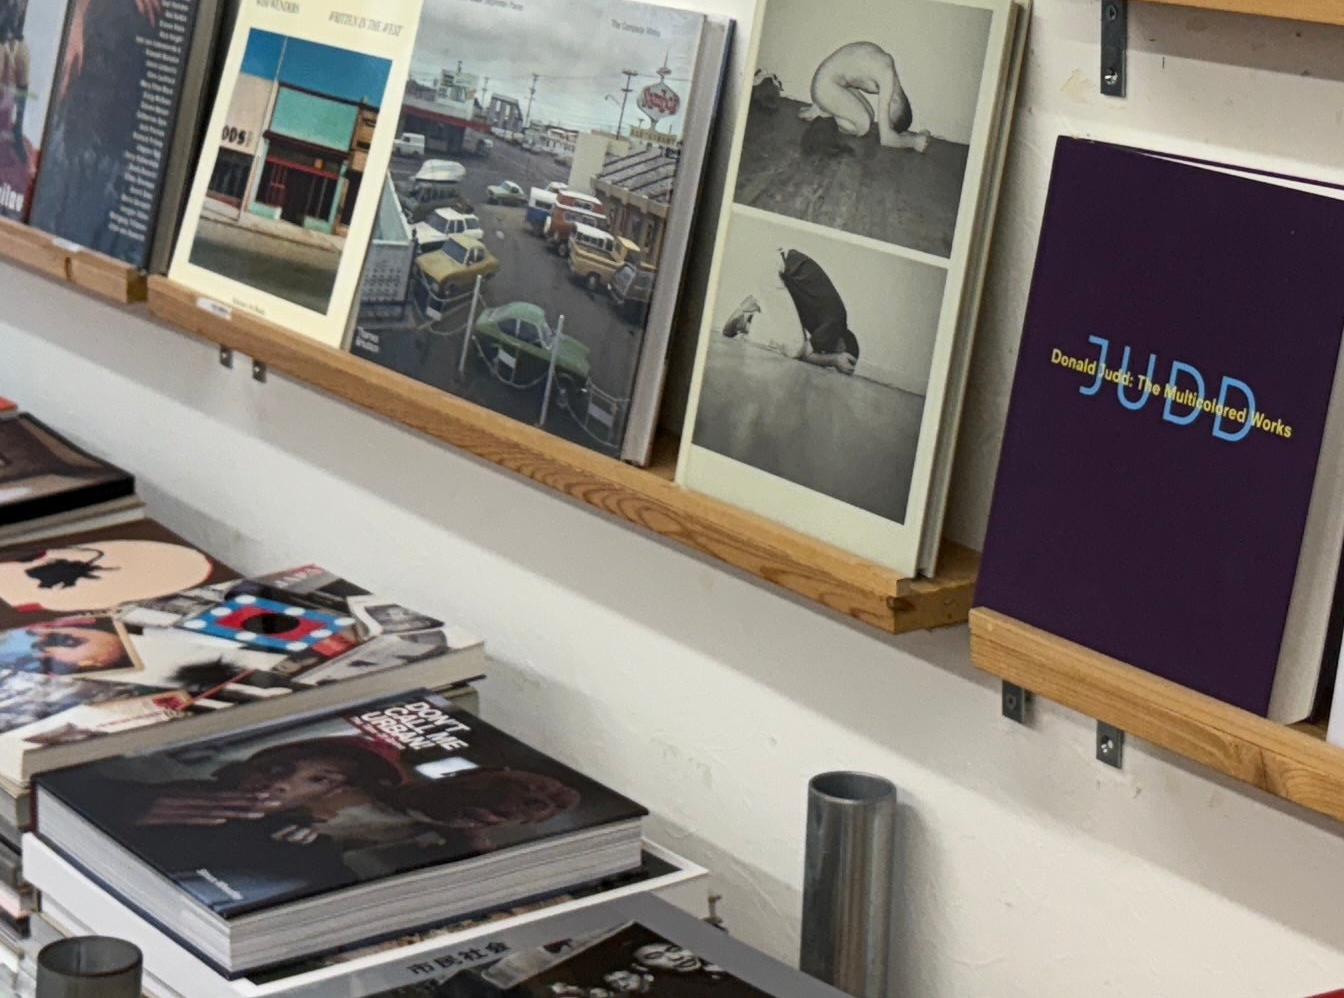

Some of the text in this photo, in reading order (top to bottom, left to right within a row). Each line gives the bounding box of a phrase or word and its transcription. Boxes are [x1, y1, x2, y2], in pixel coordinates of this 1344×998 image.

[1050, 348, 1293, 439] Donald Judd: The Multicolored Works
[1079, 334, 1257, 442] JUDD
[384, 706, 435, 735] CALL
[425, 731, 470, 751] ME
